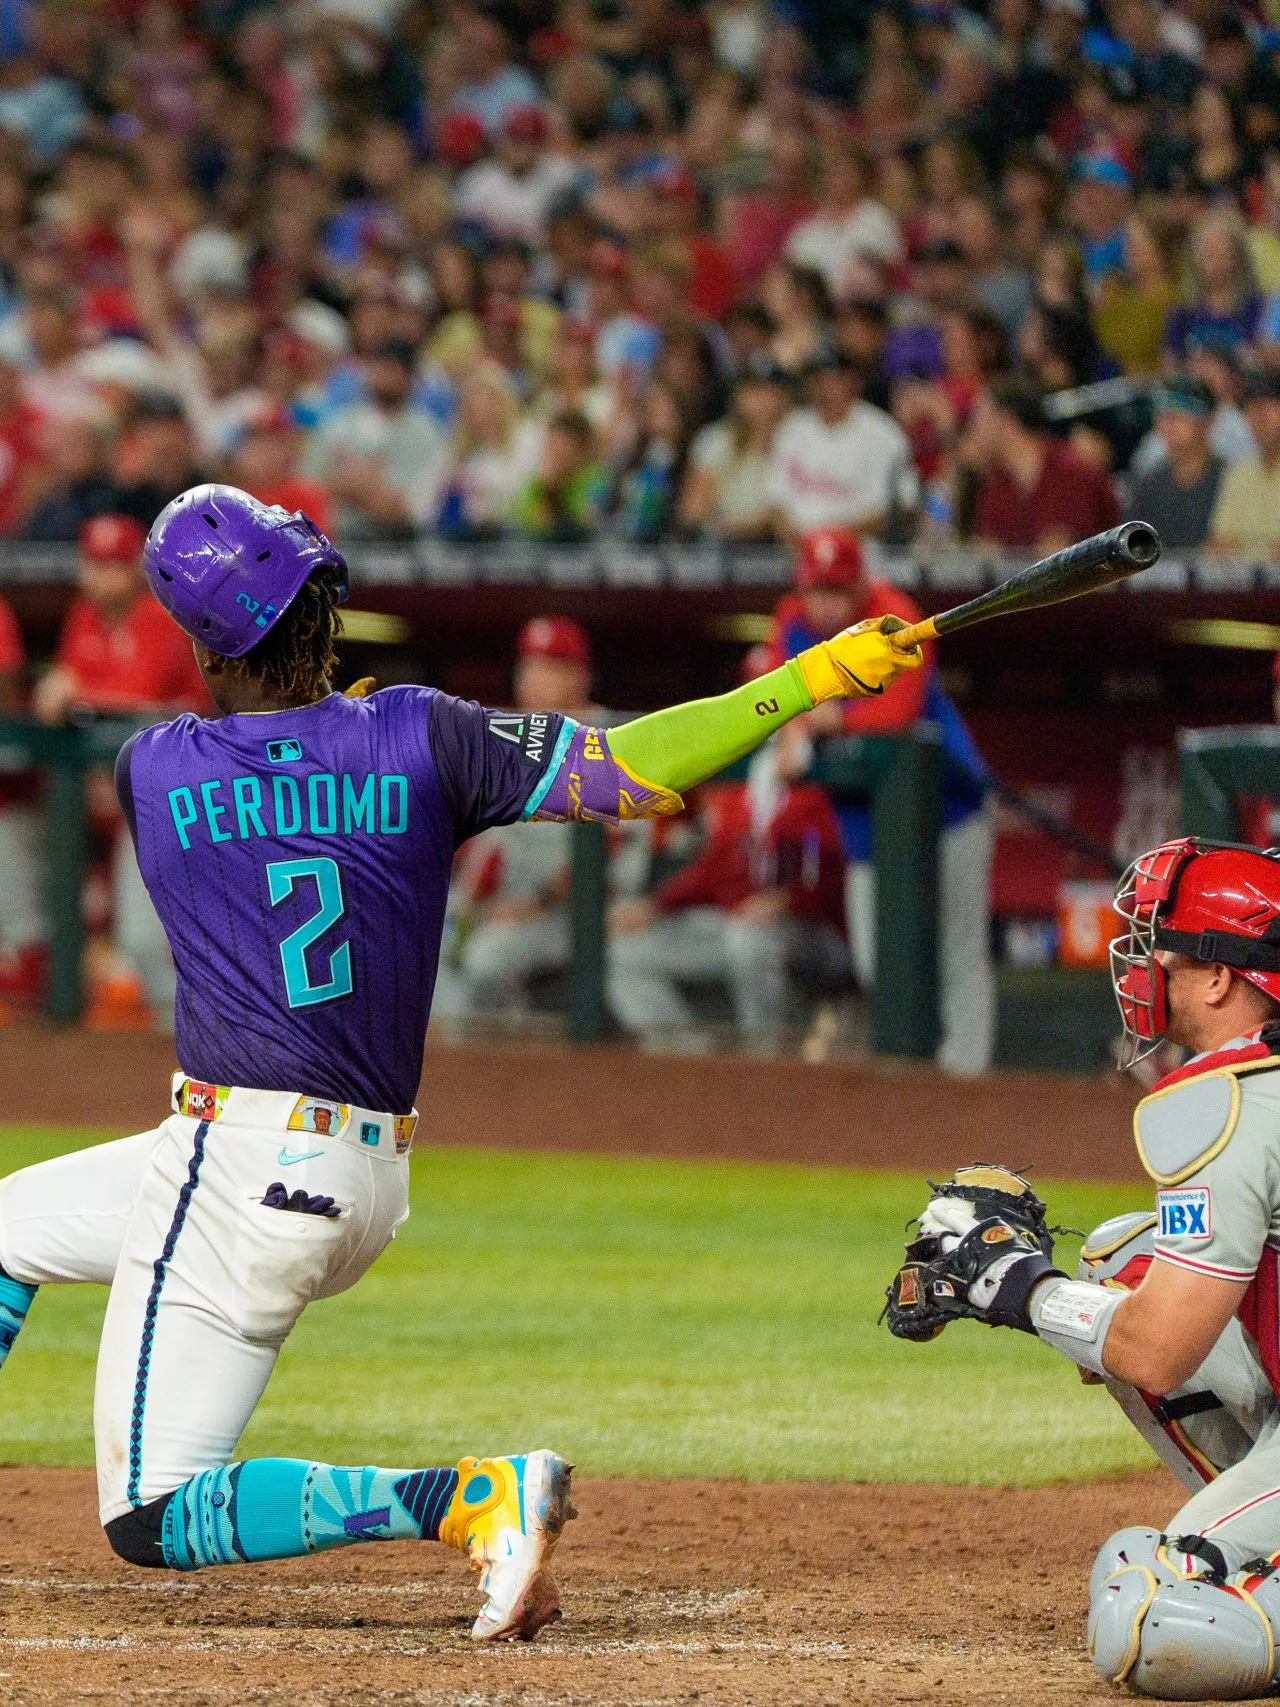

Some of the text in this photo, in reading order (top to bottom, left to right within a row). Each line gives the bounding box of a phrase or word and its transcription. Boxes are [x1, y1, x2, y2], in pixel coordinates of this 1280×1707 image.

[755, 699, 780, 716] 2
[526, 714, 548, 762] AVNET
[167, 772, 409, 850] PERDOMO
[265, 856, 353, 1009] 2
[1161, 1203, 1206, 1235] IBX
